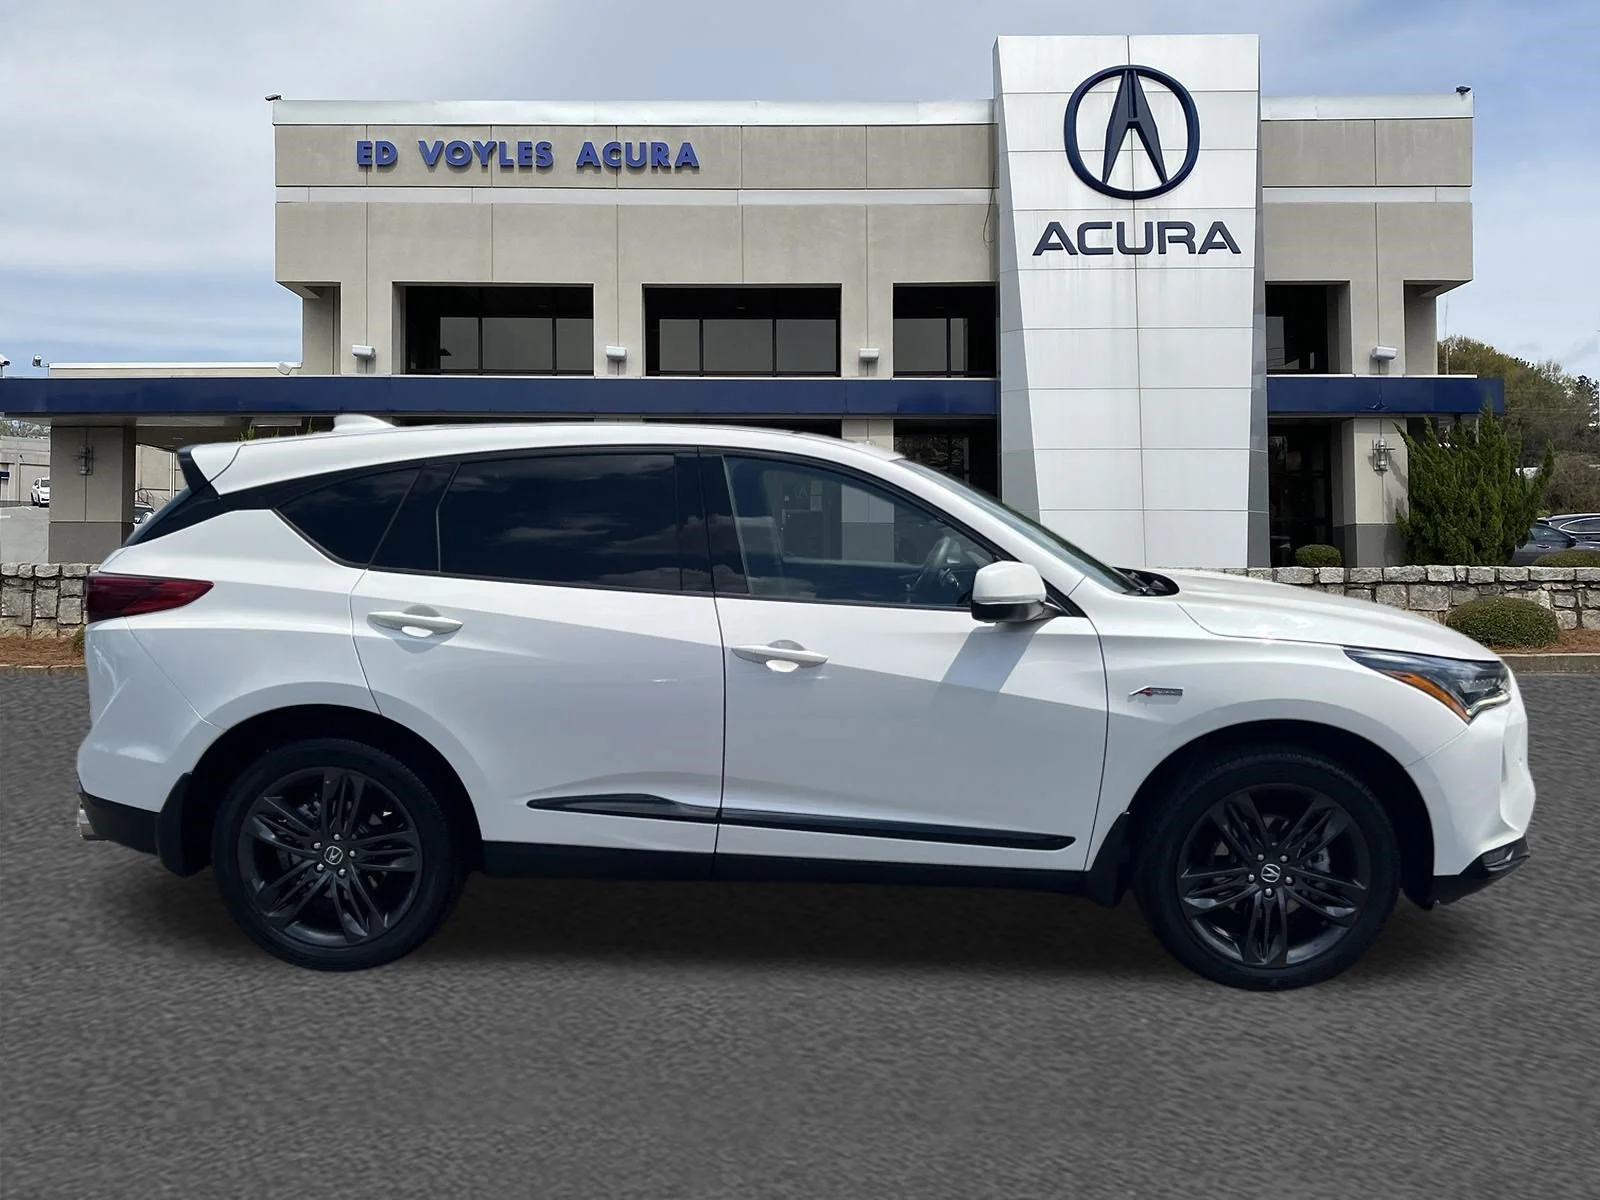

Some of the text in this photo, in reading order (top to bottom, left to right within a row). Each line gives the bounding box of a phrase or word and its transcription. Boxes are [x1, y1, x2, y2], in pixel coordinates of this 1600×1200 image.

[356, 140, 700, 169] ED VOYLES ACURA
[1032, 221, 1242, 256] ACURA
